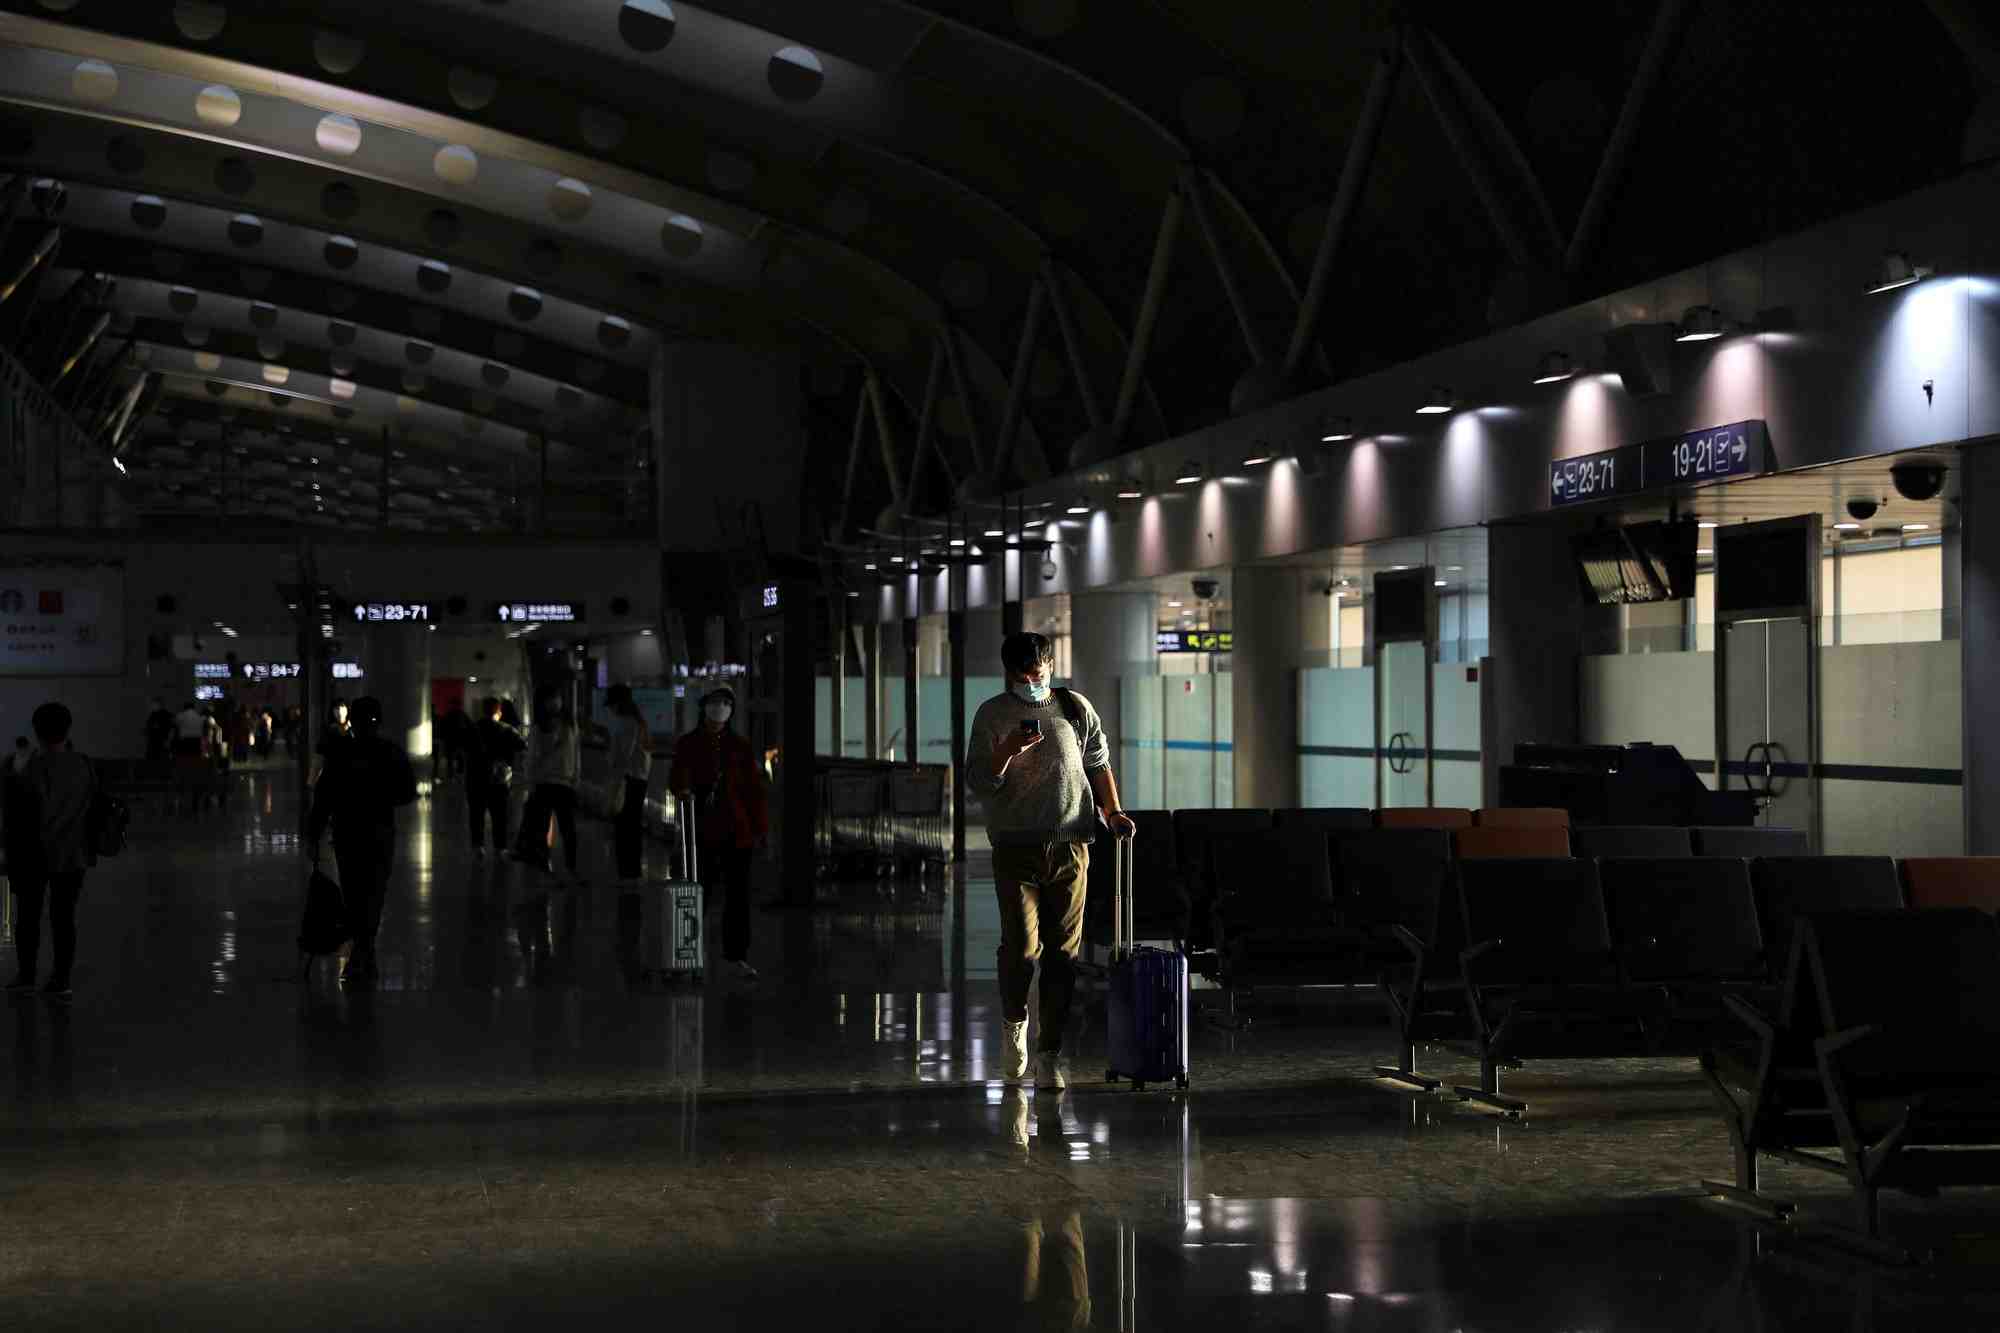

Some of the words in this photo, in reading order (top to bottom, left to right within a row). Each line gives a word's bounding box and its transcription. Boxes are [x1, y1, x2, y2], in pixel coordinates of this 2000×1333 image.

[1579, 457, 1616, 494] 23-71
[1672, 438, 1714, 478] 19-21
[384, 604, 428, 620] 23-71
